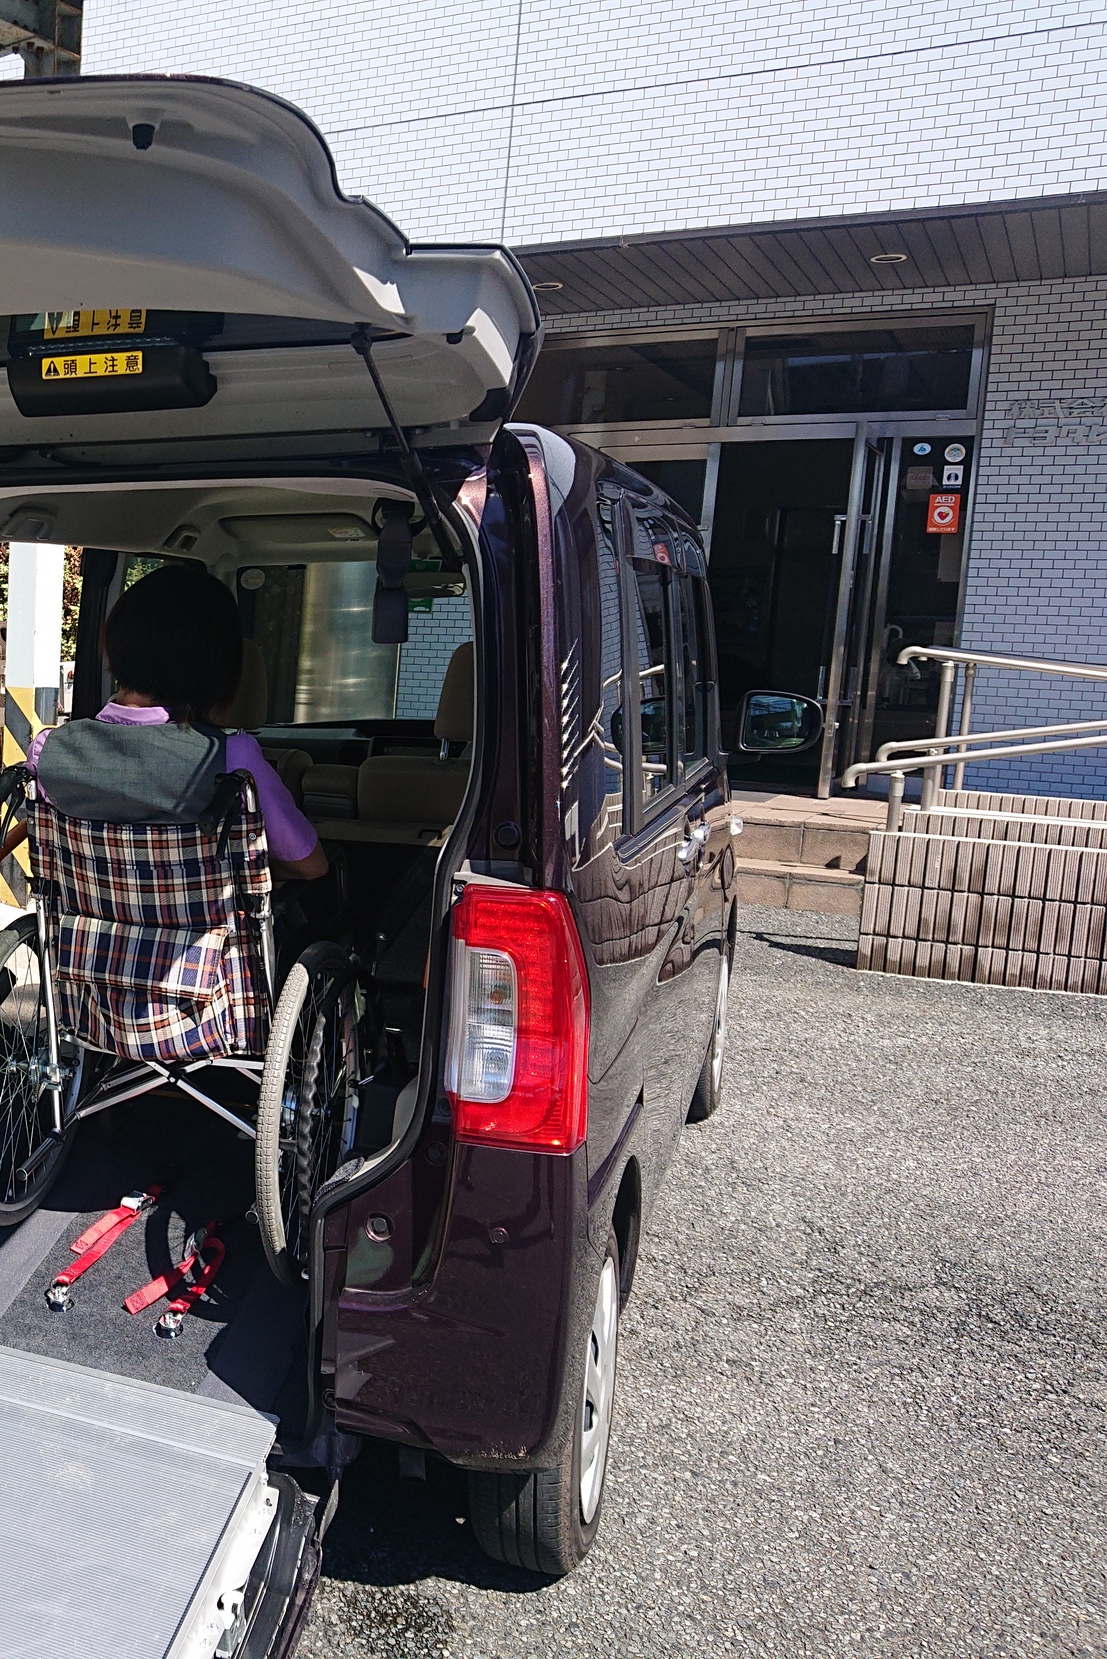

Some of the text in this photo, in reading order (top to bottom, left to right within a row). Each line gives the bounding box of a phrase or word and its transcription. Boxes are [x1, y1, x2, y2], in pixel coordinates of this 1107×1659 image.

[63, 354, 140, 376] 頭上注意
[934, 495, 956, 503] AED
